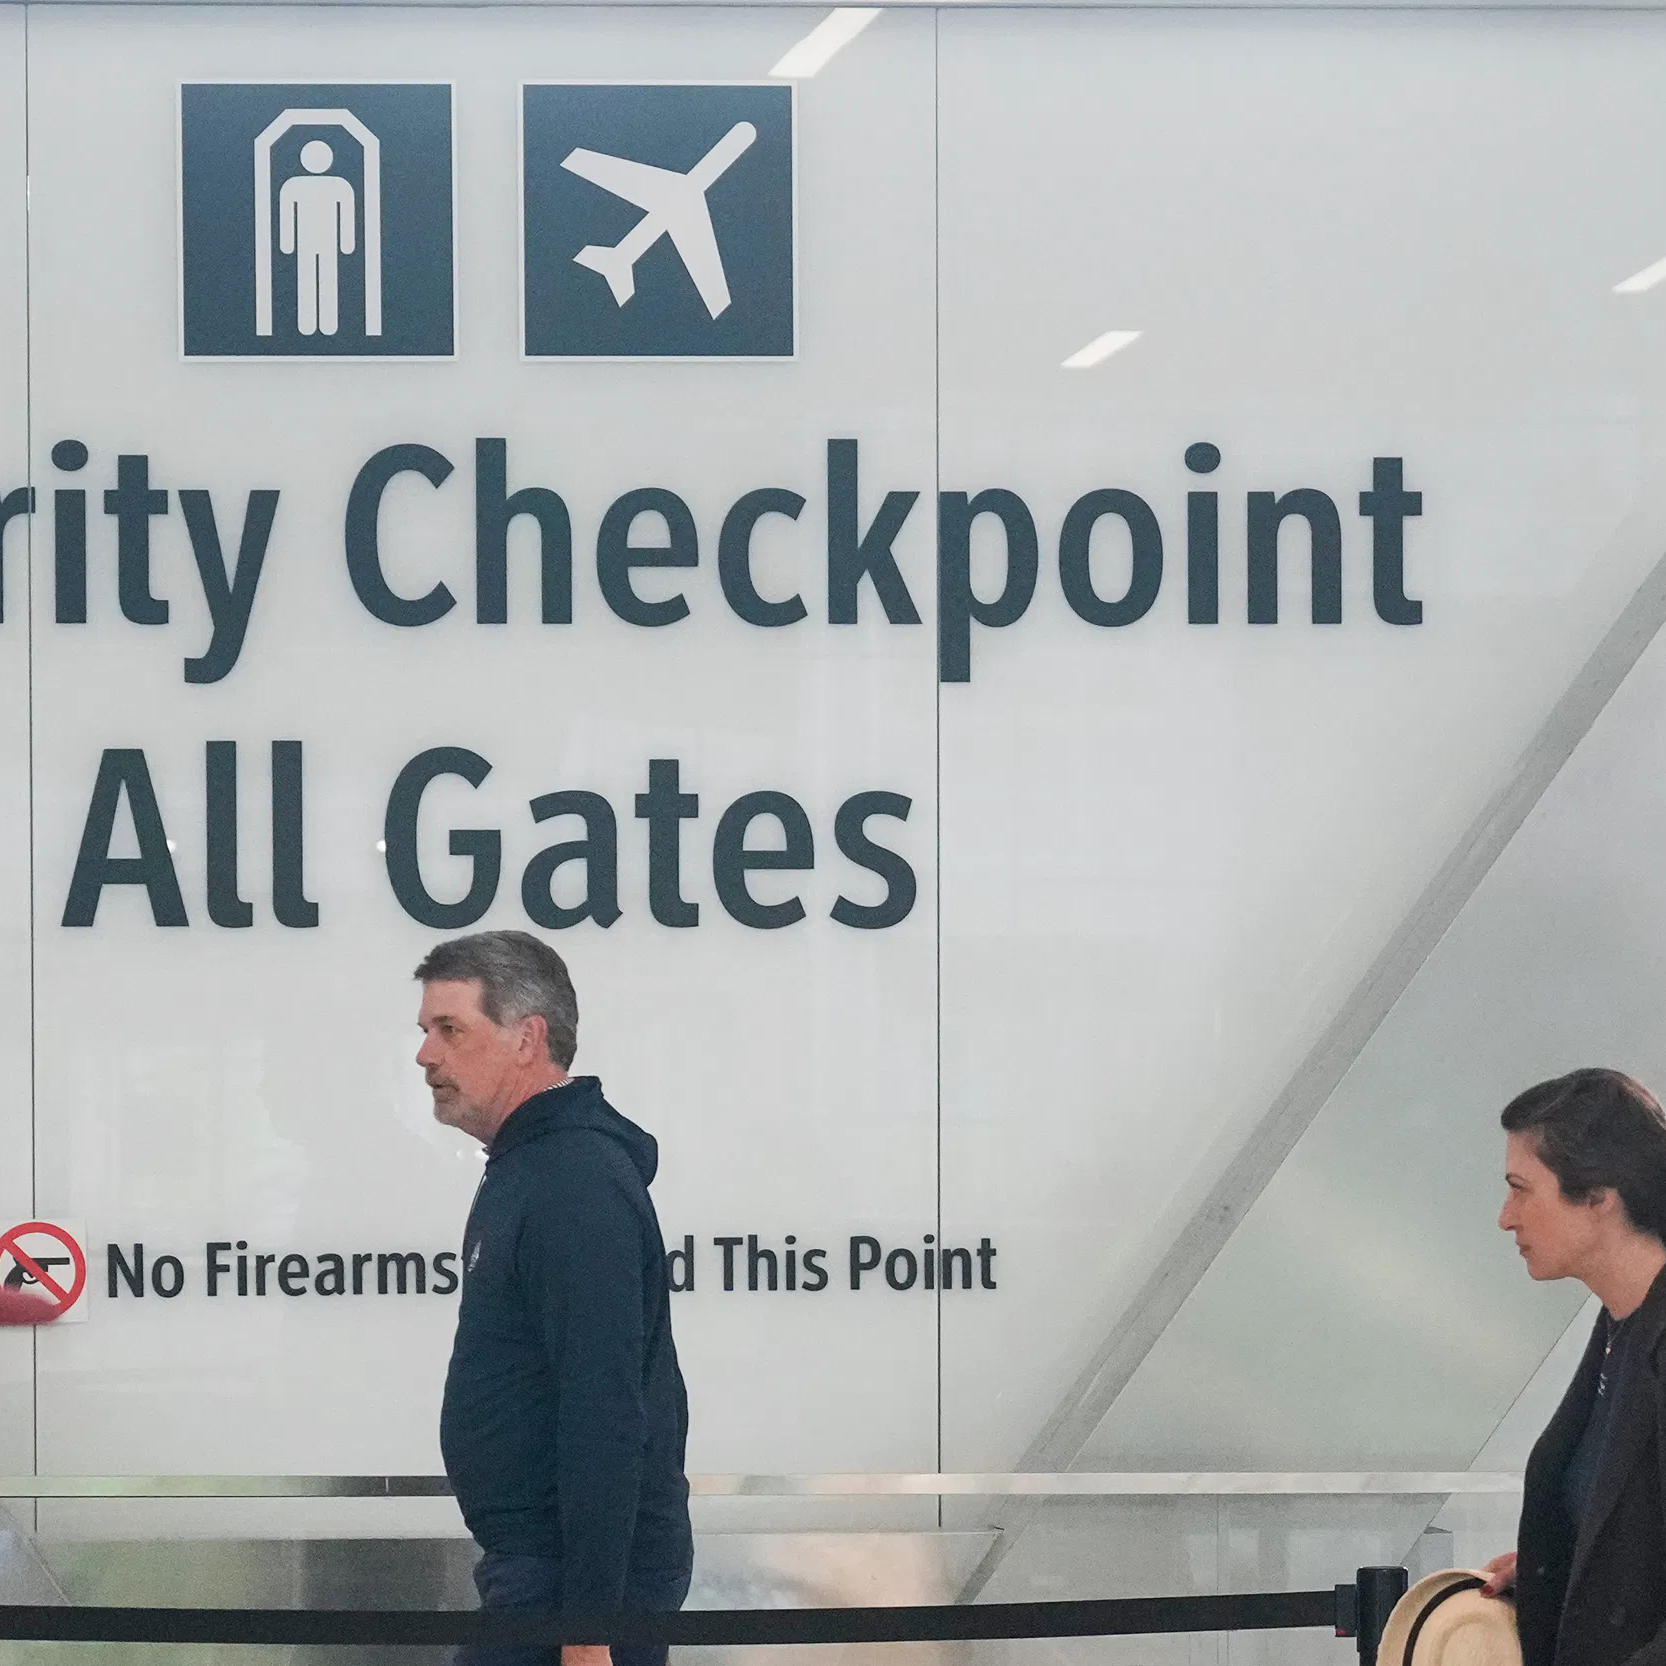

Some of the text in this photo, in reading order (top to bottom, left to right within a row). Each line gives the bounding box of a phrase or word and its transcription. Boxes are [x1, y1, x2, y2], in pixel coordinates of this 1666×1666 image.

[344, 438, 1423, 683] Checkpoint
[61, 741, 917, 930] All Gates
[107, 1243, 185, 1299] No
[206, 1241, 459, 1297] Firearms
[713, 1235, 829, 1292] This
[849, 1235, 998, 1291] Point
